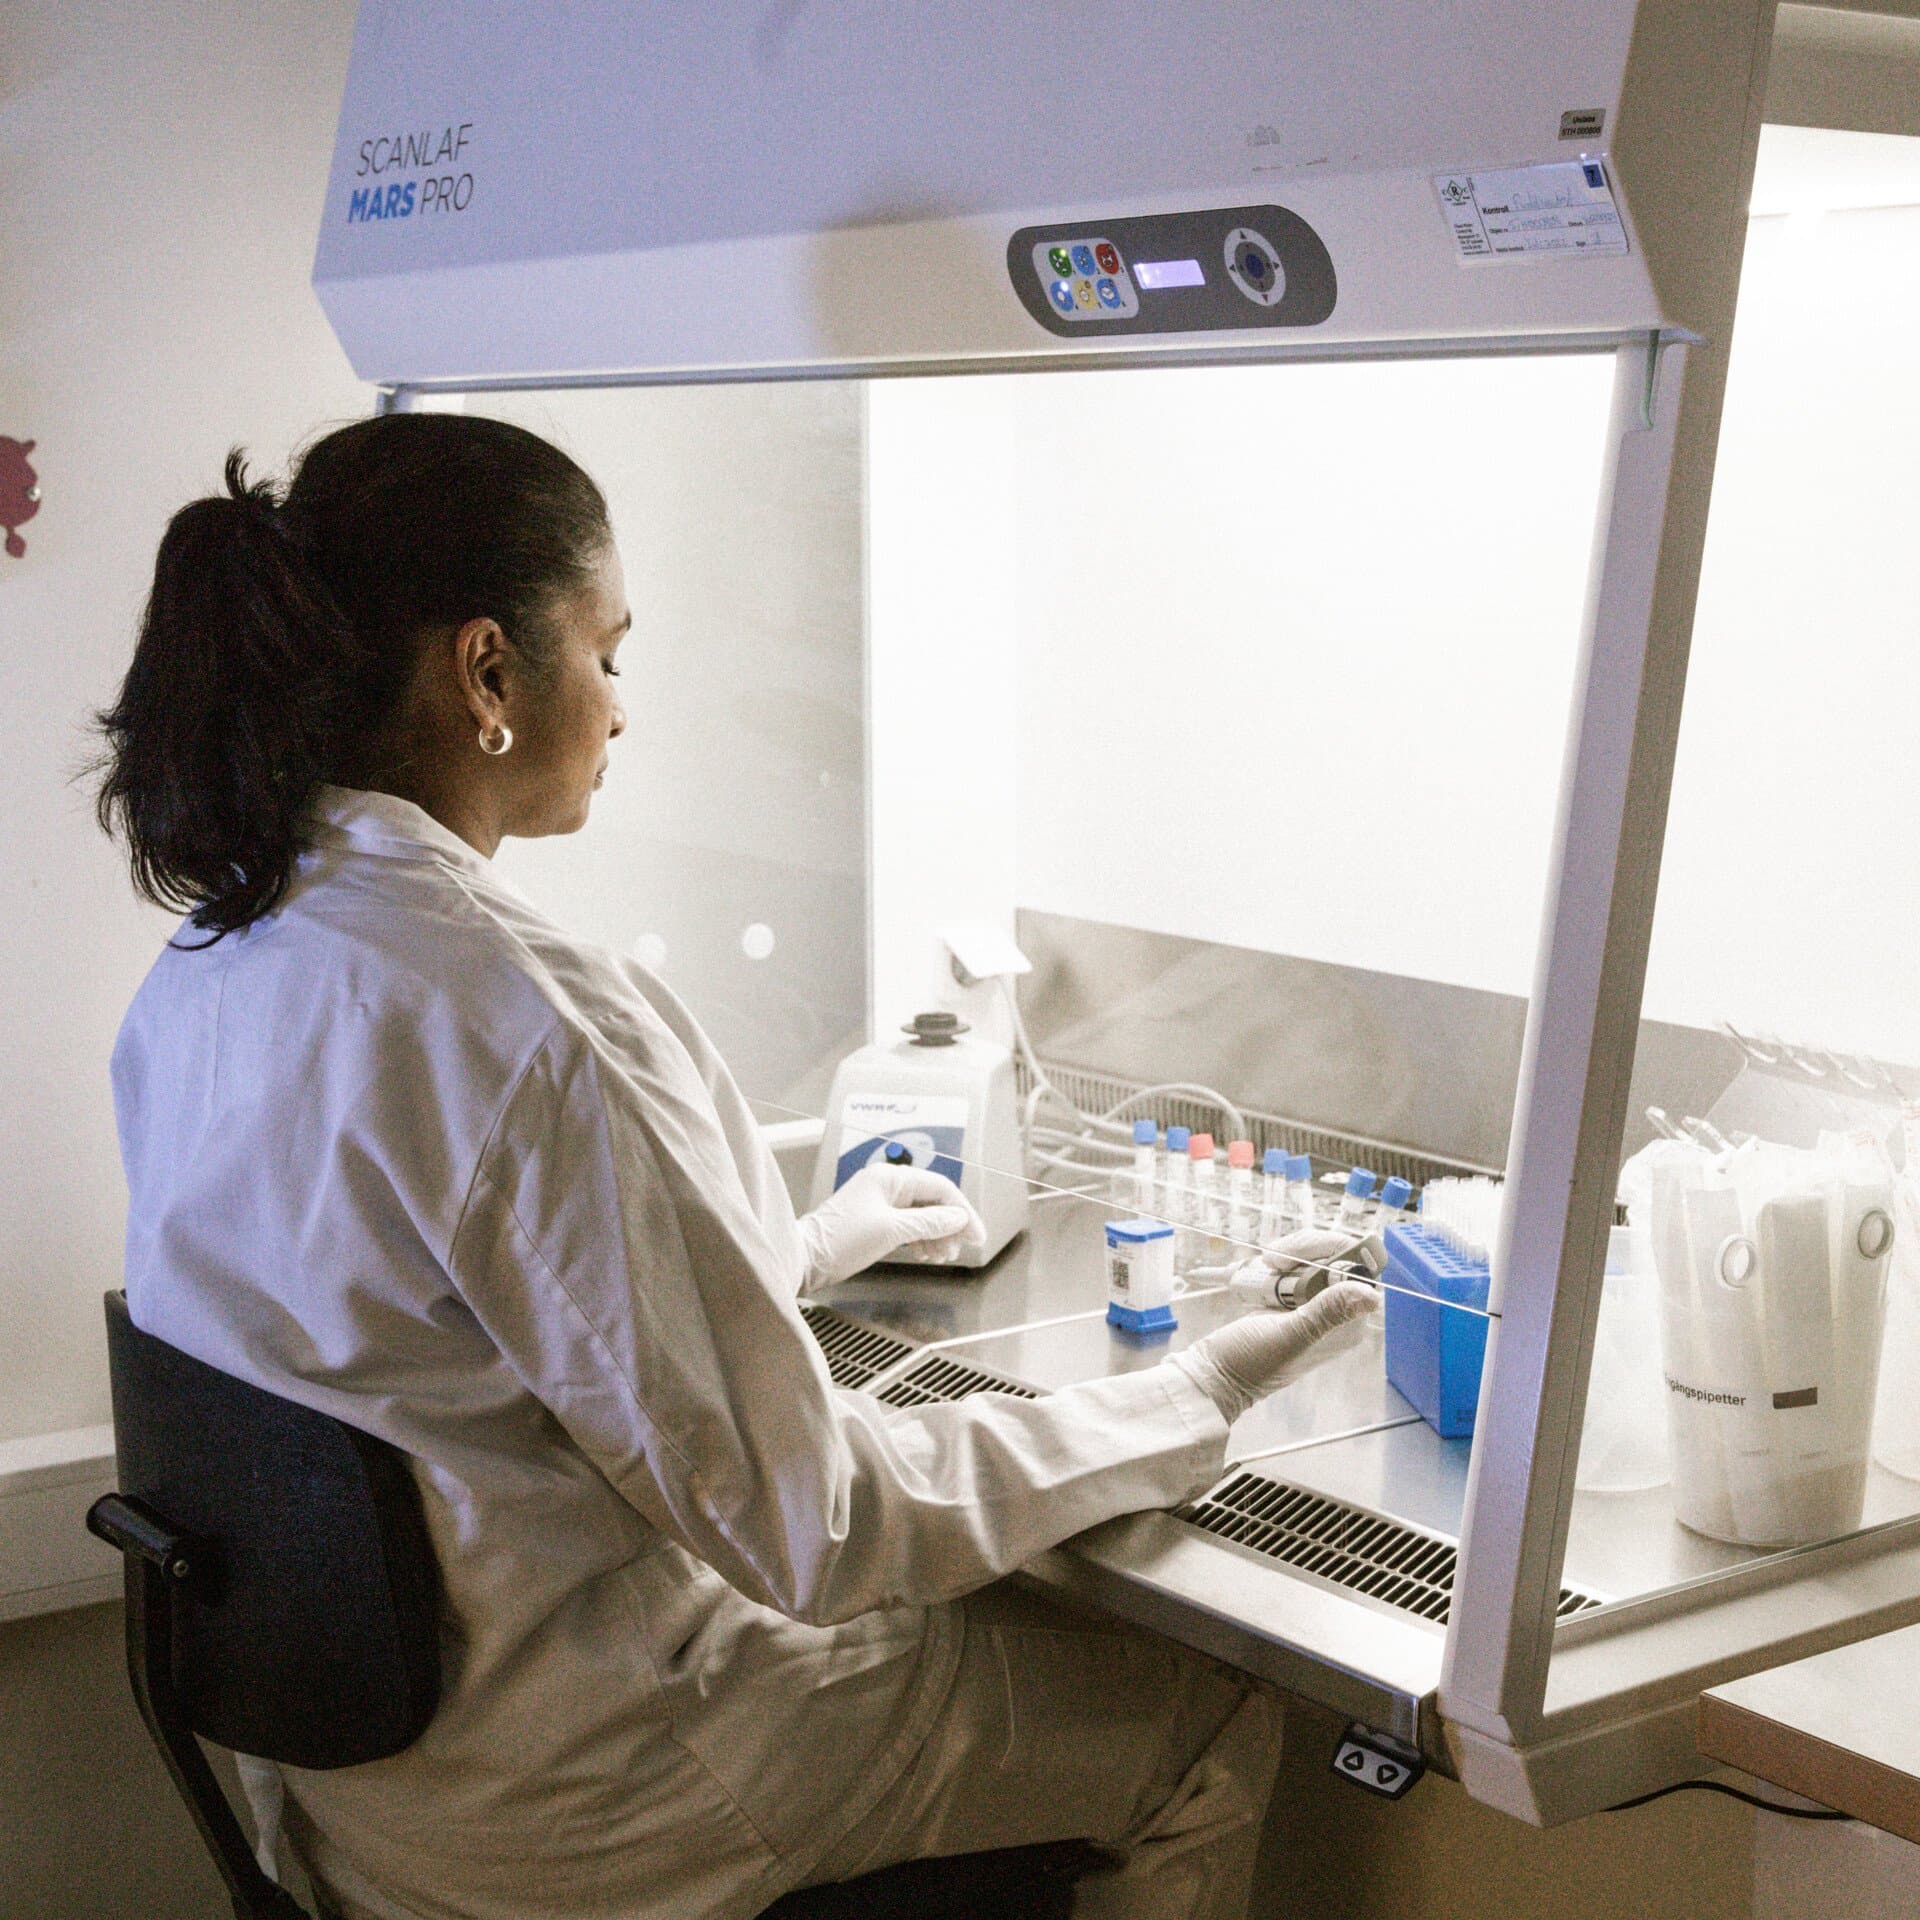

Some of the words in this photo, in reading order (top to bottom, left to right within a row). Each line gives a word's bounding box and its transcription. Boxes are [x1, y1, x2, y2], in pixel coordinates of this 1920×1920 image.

[356, 123, 473, 177] SCANLAF
[348, 181, 417, 224] MARS
[420, 173, 474, 214] PRO
[1482, 204, 1509, 215] Kontroll
